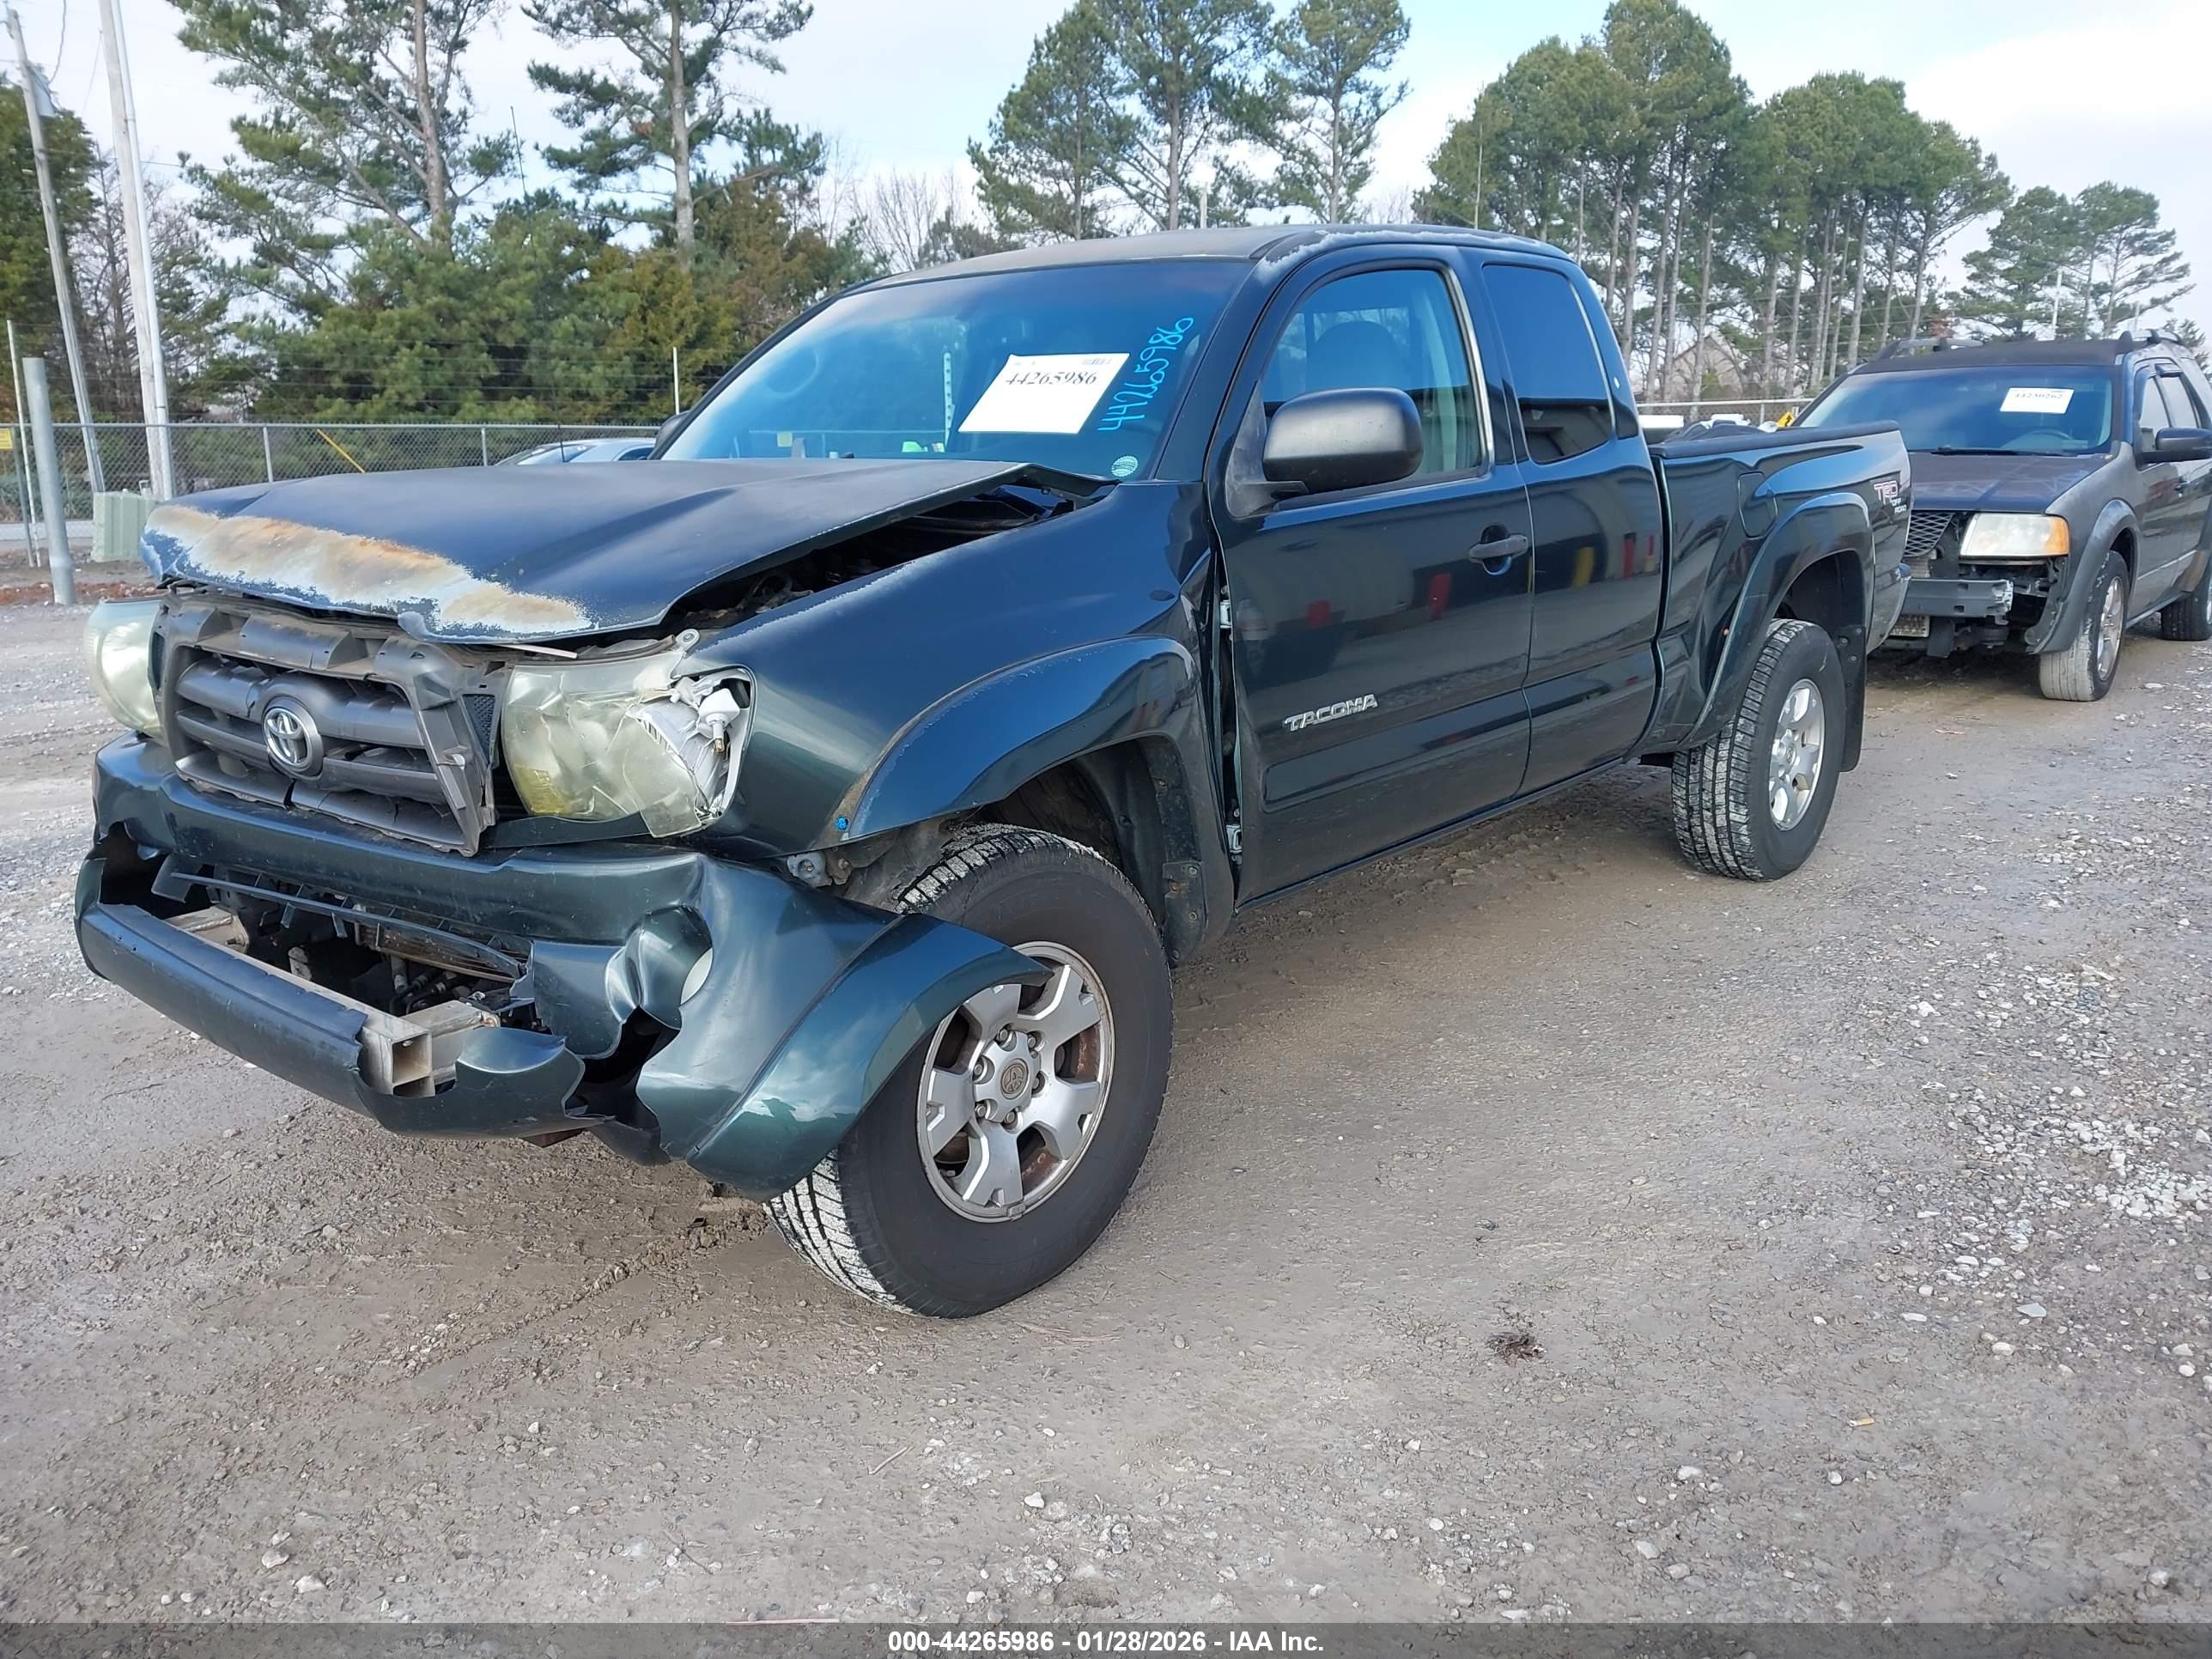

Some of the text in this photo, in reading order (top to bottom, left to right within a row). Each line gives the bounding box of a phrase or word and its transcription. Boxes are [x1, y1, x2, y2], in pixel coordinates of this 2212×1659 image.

[1005, 371, 1098, 385] 44265986
[1097, 317, 1194, 431] 44265986
[1873, 480, 1899, 506] TRD
[1284, 693, 1378, 732] TACOMA
